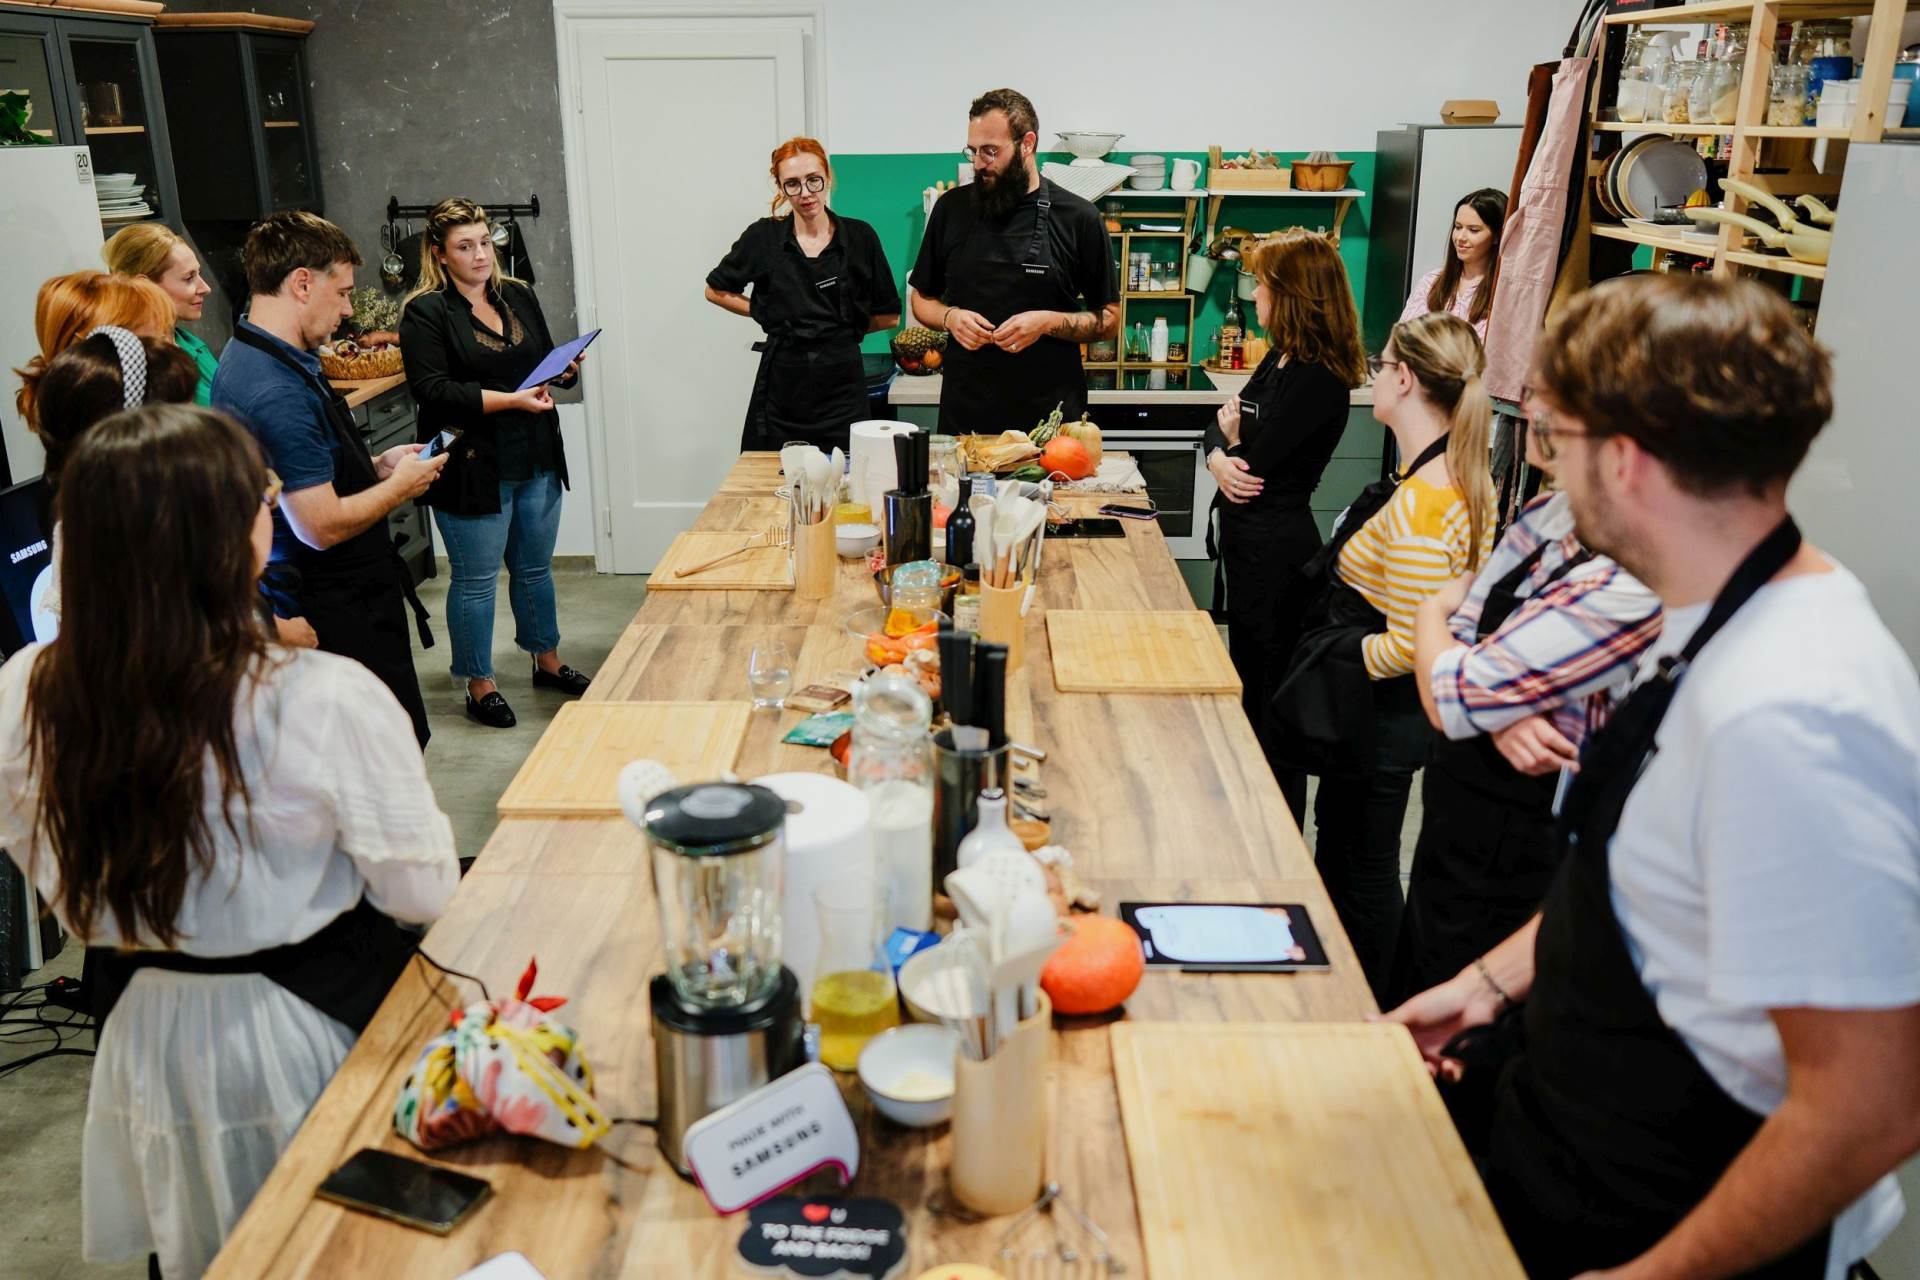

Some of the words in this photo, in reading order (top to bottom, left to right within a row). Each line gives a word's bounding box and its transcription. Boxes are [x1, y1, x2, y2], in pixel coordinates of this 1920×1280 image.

[77, 153, 88, 168] 20
[10, 540, 48, 564] SAMSUNG
[732, 1120, 821, 1177] SAMSUNG
